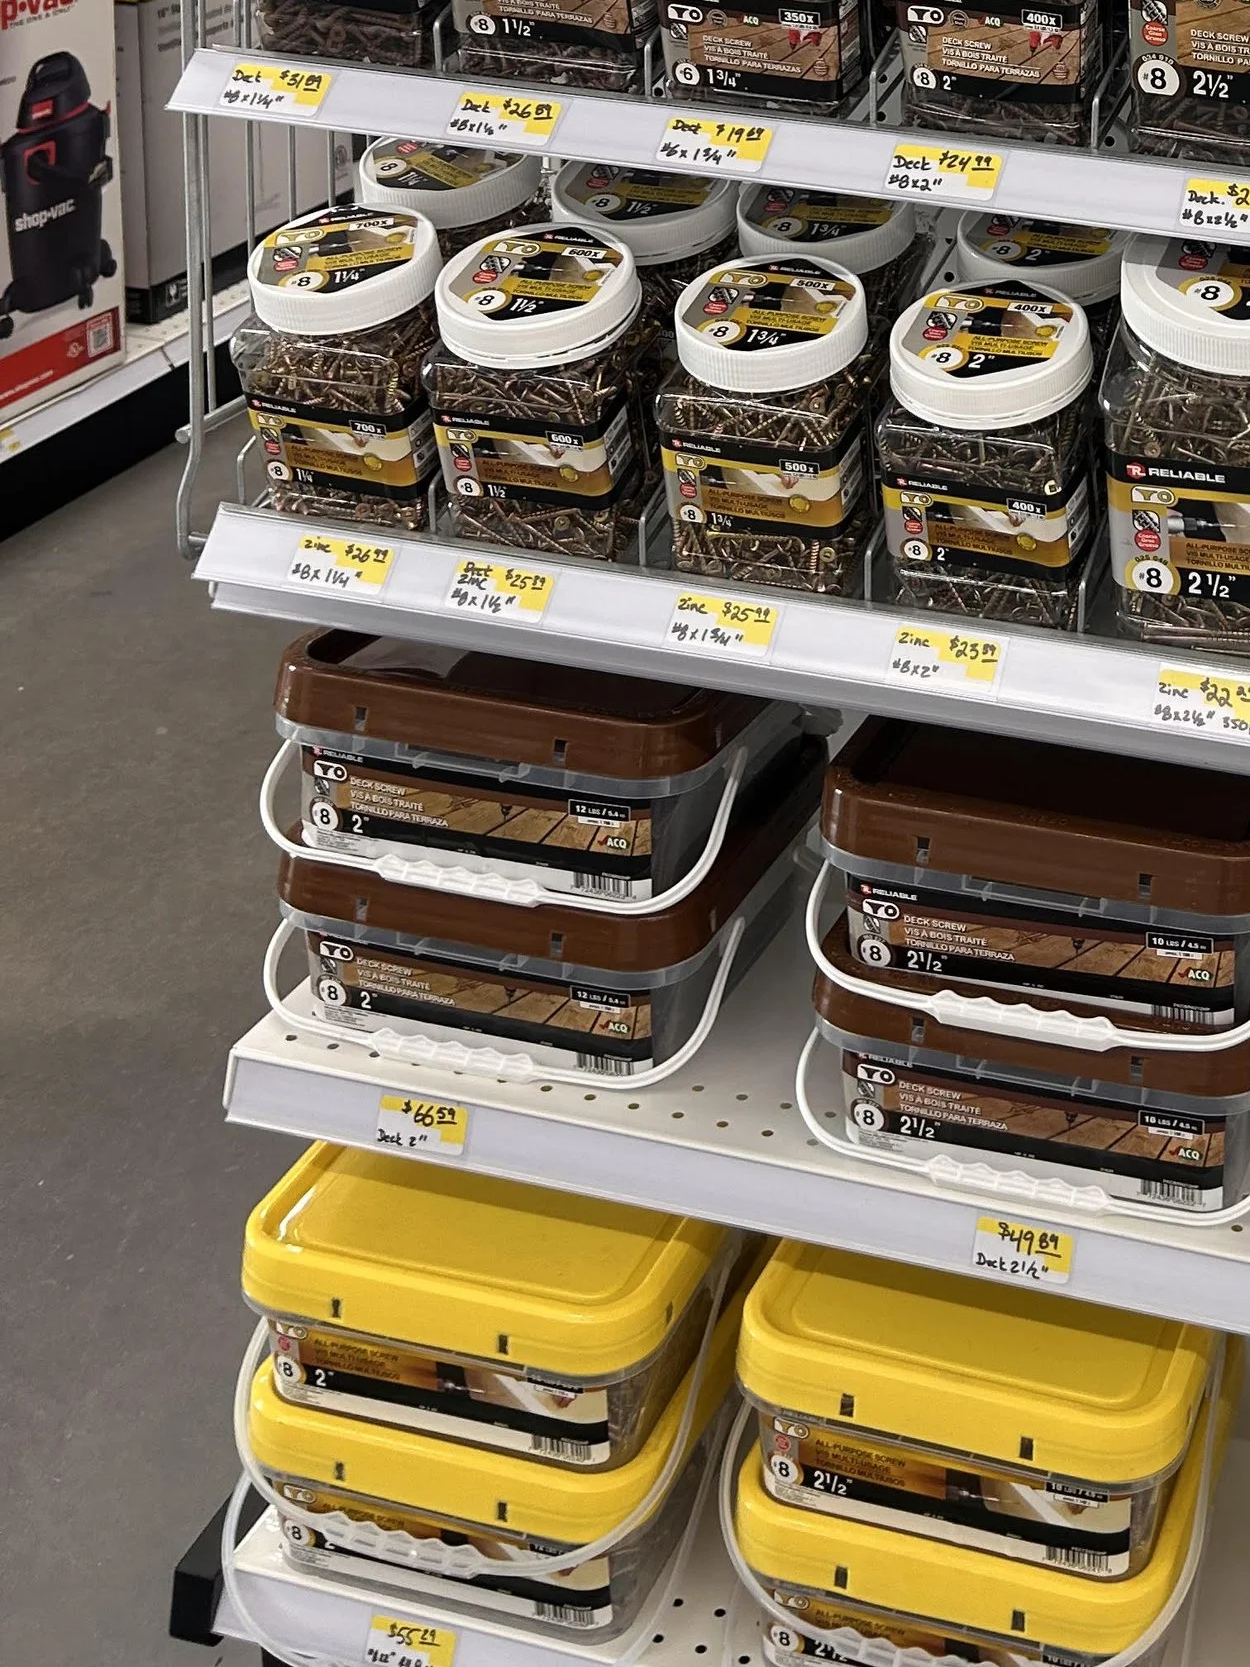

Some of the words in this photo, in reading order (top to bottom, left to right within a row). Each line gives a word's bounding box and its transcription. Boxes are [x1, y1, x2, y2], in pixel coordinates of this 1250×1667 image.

[984, 16, 1001, 27] ACQ
[1190, 28, 1215, 40] DECK
[1216, 31, 1250, 44] SCREW
[1191, 51, 1234, 65] TORNILLO
[893, 155, 932, 171] Deck
[1148, 467, 1226, 484] RELIABLE
[908, 479, 949, 492] RELIABLE
[322, 749, 364, 764] RELIABLE
[606, 836, 628, 850] ACQ
[872, 888, 918, 902] RELIABLE
[903, 914, 932, 928] DECK
[931, 918, 967, 933] SCREW
[1187, 968, 1210, 982] ACQ
